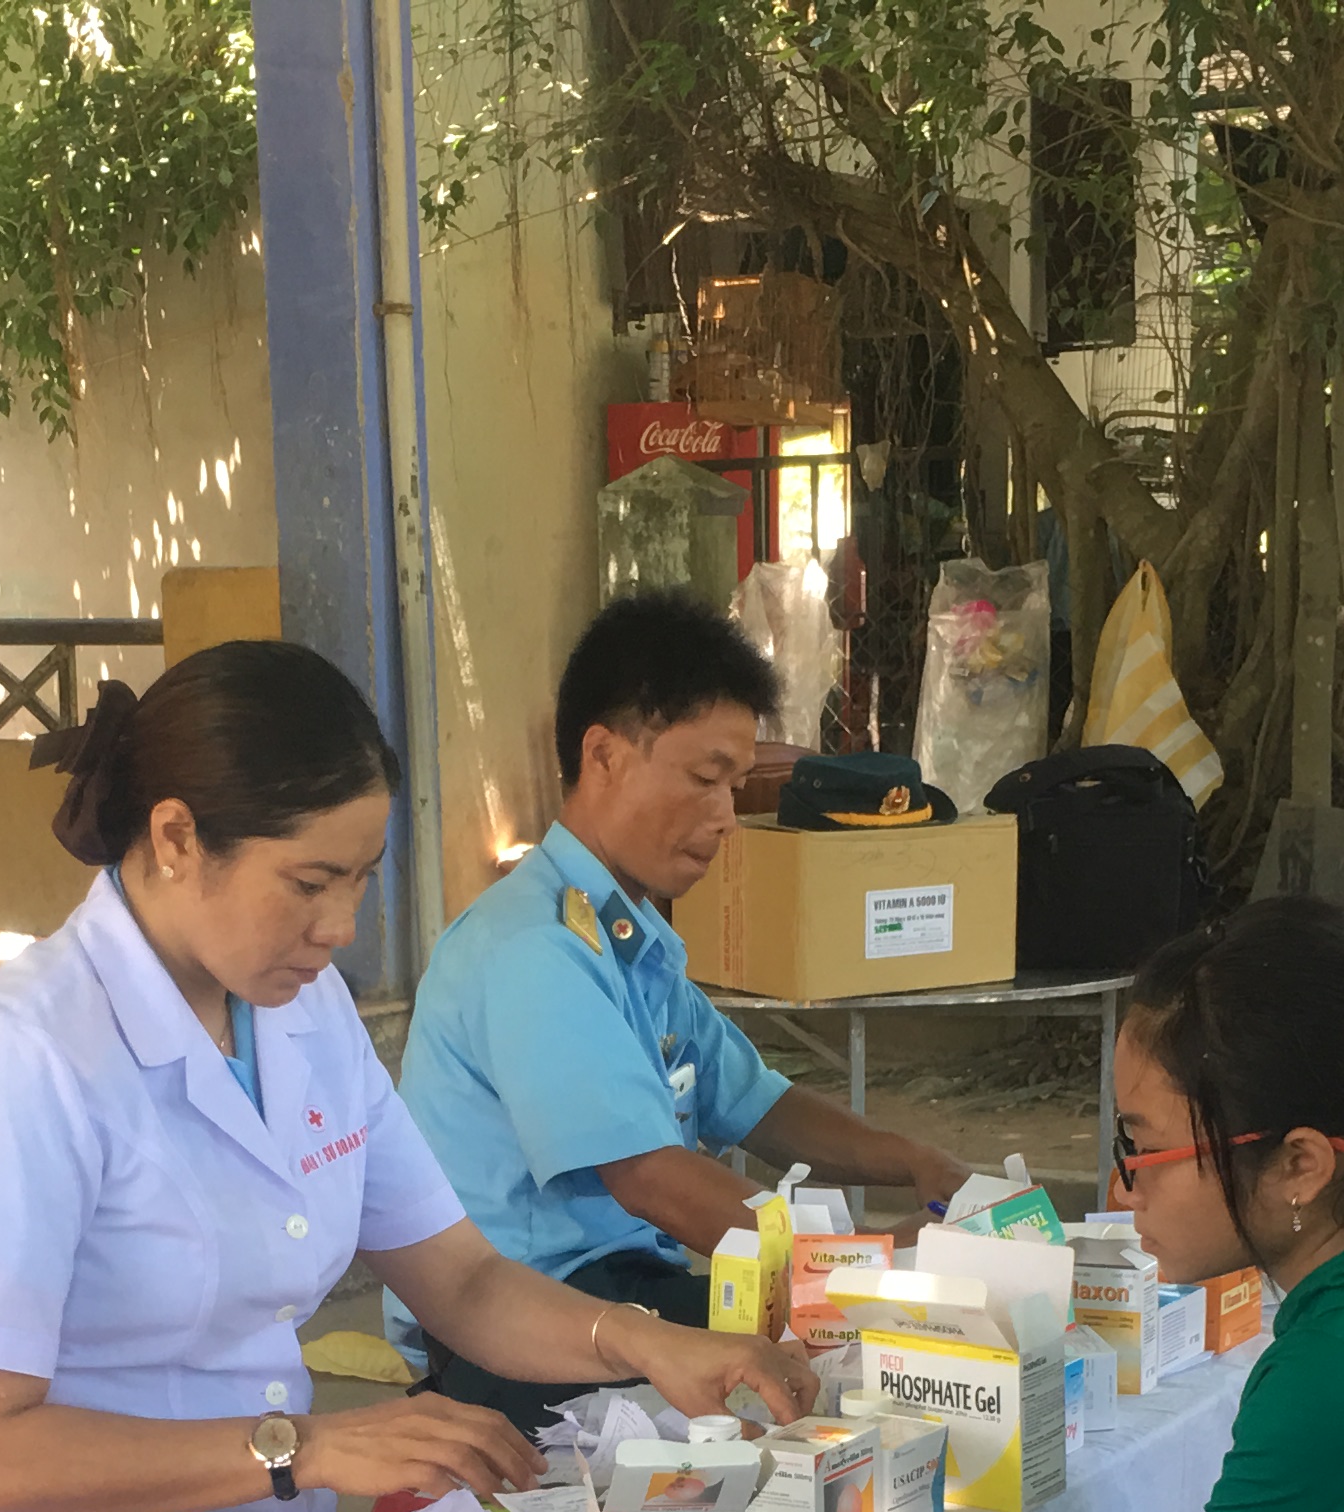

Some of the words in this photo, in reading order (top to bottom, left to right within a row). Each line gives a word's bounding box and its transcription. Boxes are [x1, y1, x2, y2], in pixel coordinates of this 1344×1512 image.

[640, 420, 724, 454] Coca-Cola
[874, 897, 907, 911] VITAMIN
[909, 898, 915, 908] A
[810, 1251, 873, 1266] Vita-apha
[1072, 1280, 1130, 1303] laxon
[809, 1327, 862, 1342] Vita-aph
[879, 1353, 904, 1372] MEDI
[880, 1370, 971, 1411] PHOSPHATE
[975, 1386, 1001, 1415] Gel
